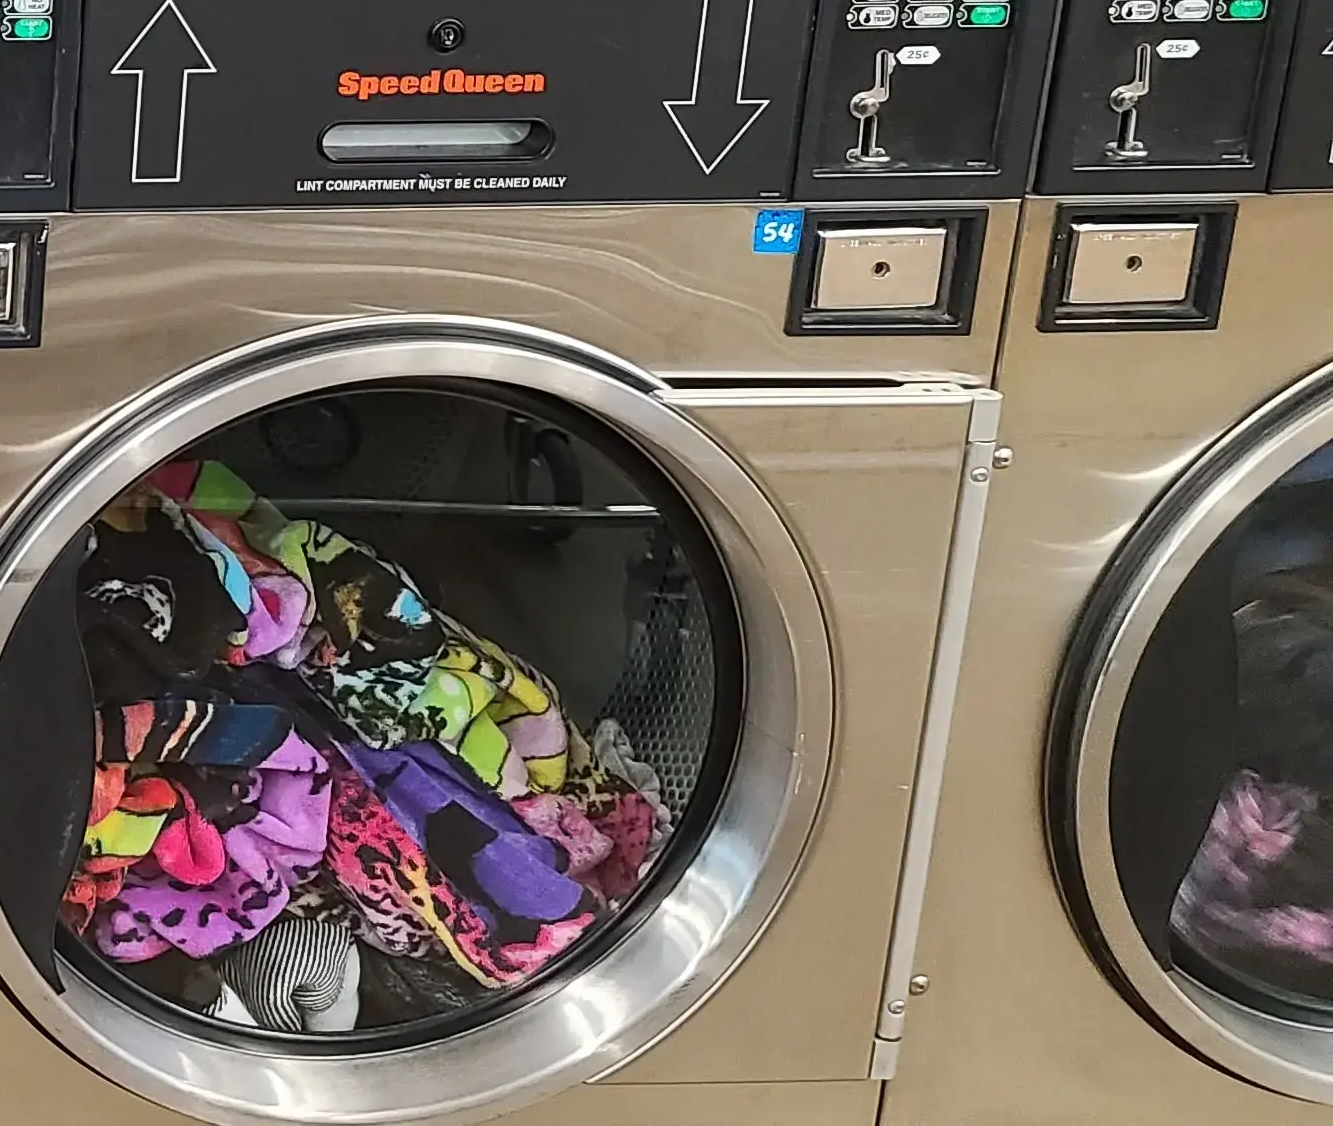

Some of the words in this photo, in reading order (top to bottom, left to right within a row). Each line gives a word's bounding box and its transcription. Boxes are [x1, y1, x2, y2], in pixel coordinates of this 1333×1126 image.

[338, 70, 441, 100] Speed
[443, 69, 545, 94] Queen
[295, 179, 324, 193] LINT
[324, 178, 417, 192] COMPARTMENT
[418, 177, 452, 192] MUST
[453, 176, 472, 190] BE
[473, 176, 531, 190] CLEANED
[531, 176, 568, 189] DAILY
[763, 221, 795, 242] 54
